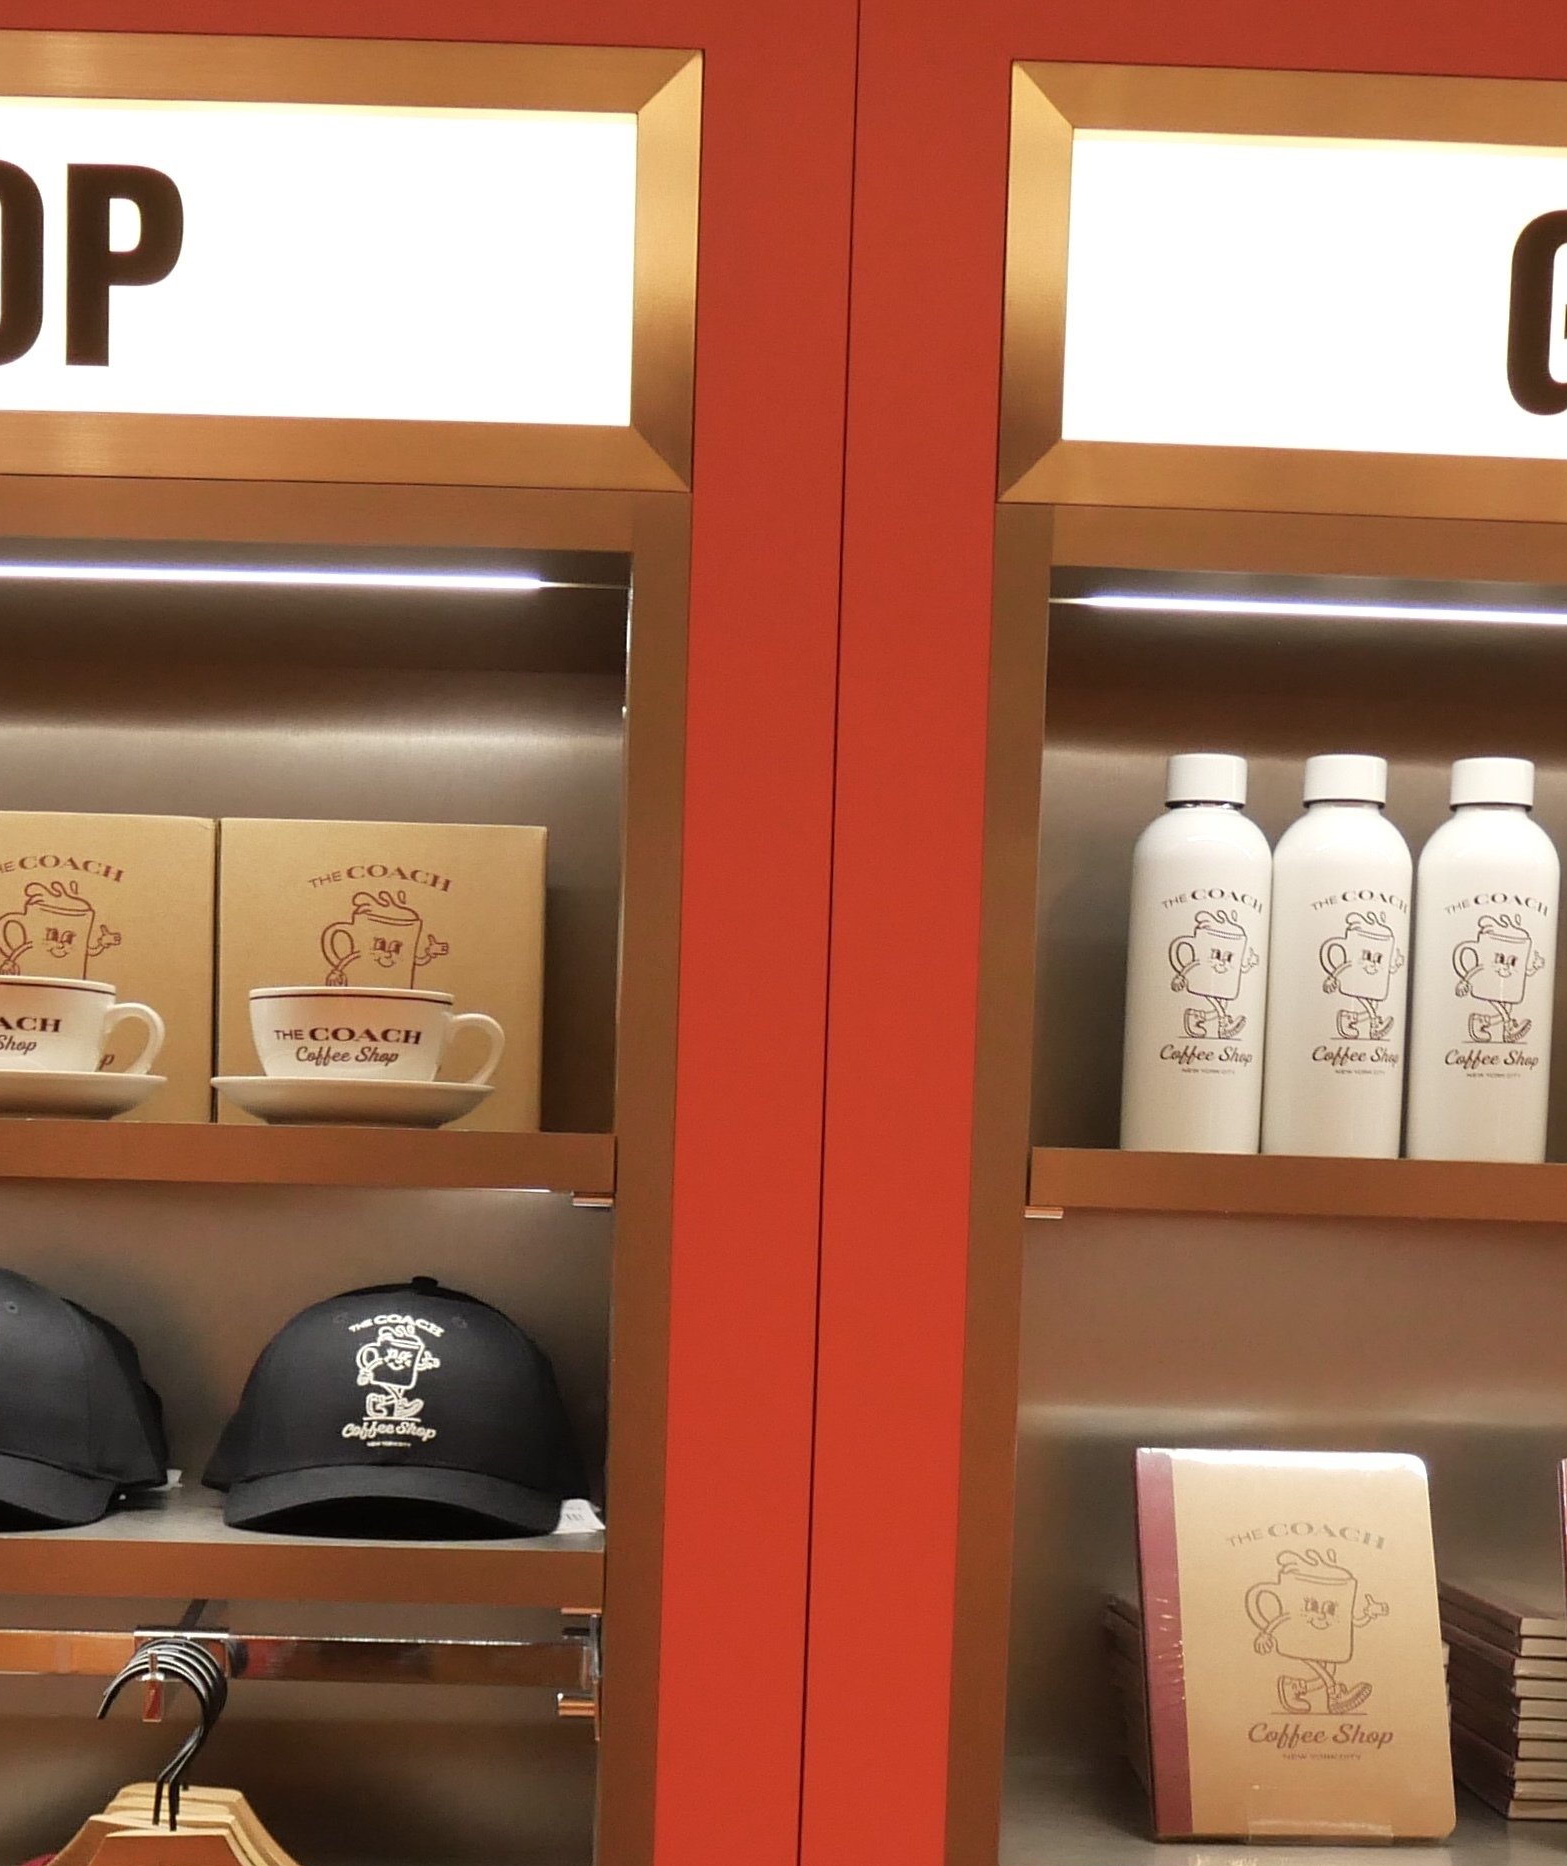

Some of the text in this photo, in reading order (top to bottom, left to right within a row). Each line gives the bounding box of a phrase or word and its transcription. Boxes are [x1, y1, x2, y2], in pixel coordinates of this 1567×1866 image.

[18, 854, 125, 882] COACH
[309, 864, 453, 893] THE COACH
[1162, 888, 1263, 914] THE COACH
[1311, 889, 1408, 915] THE COACH
[1444, 893, 1548, 917] THE COACH
[274, 1027, 422, 1045] THE COACH
[296, 1046, 399, 1066] Coffee Shop
[1160, 1044, 1252, 1064] Coffee Shop
[1312, 1045, 1399, 1066] Coffee Shop
[1444, 1049, 1539, 1069] Coffee Shop
[348, 1314, 445, 1338] THE COACH
[341, 1421, 437, 1442] Coffee Shop
[1226, 1522, 1384, 1549] THE COACH
[1248, 1722, 1394, 1749] Coffee Shop
